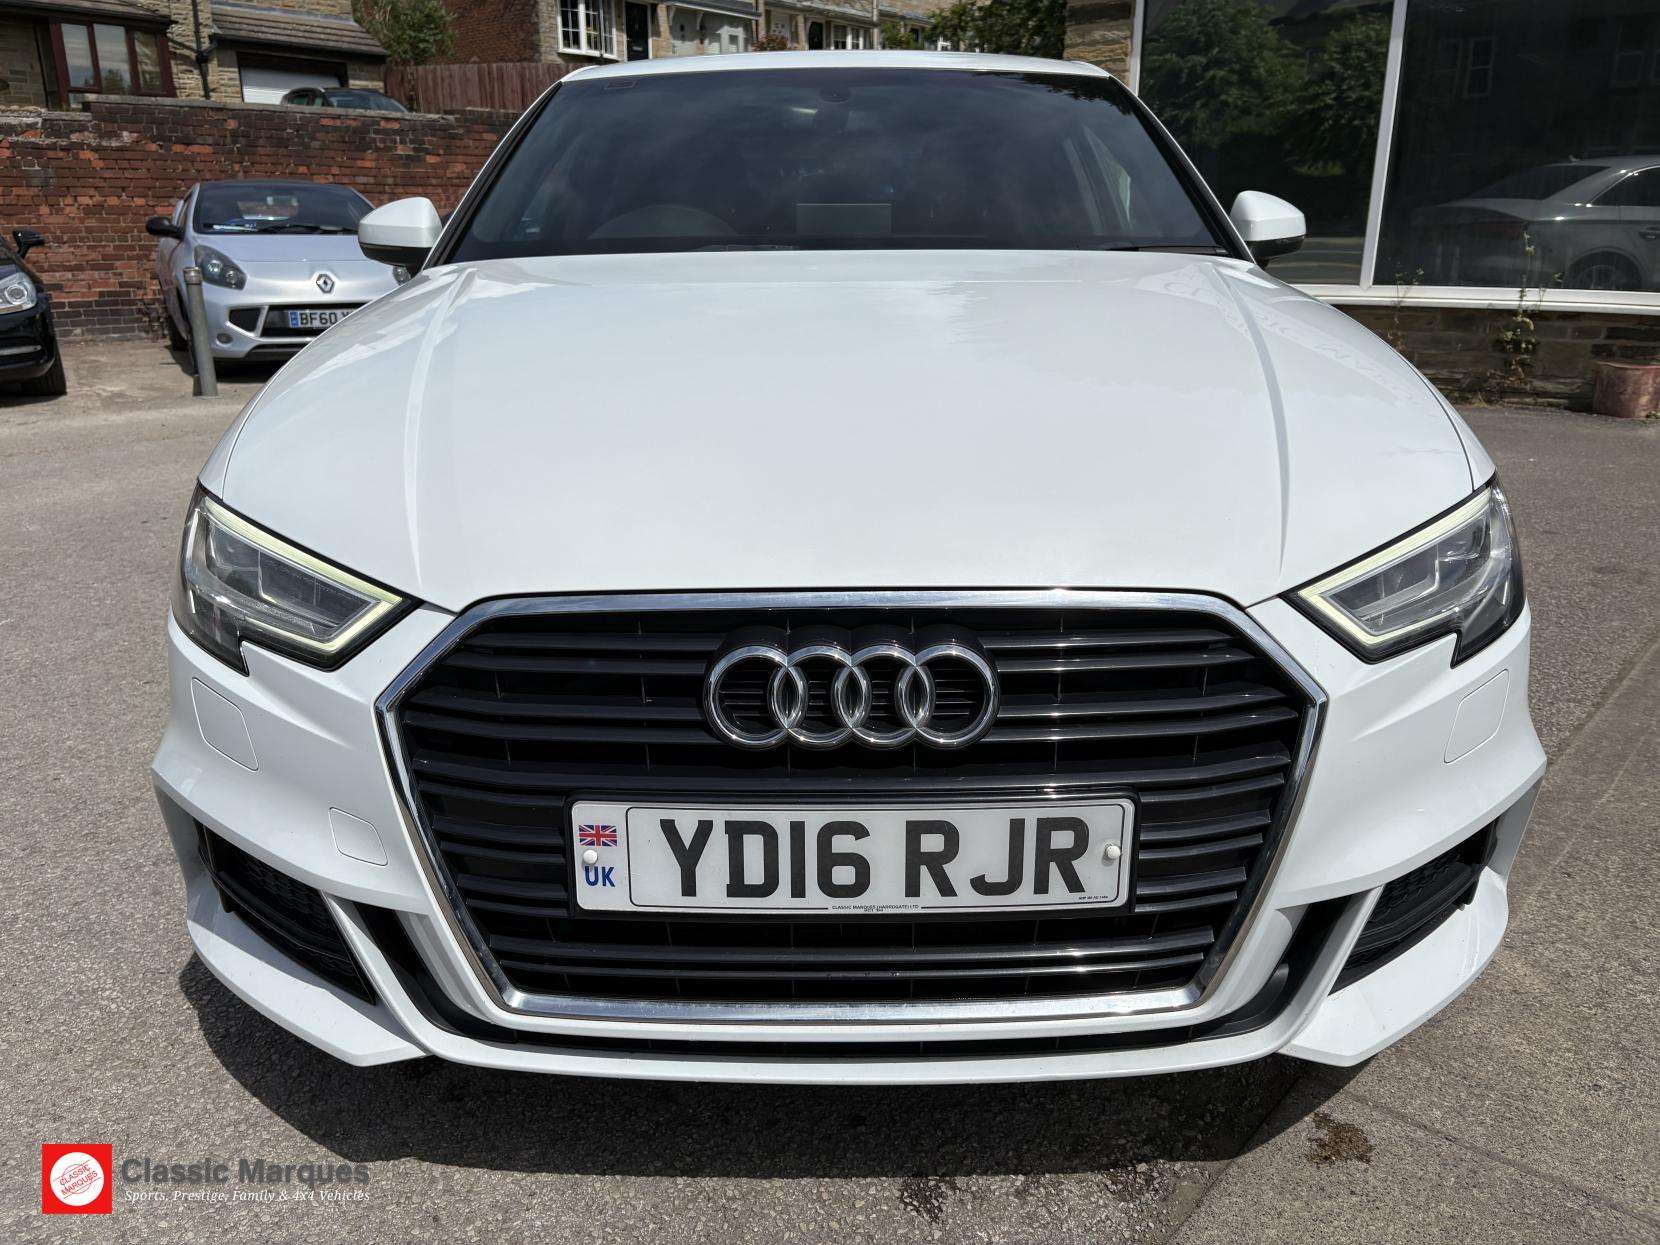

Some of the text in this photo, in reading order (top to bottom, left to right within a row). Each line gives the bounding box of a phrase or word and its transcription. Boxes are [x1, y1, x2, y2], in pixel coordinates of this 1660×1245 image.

[300, 312, 338, 325] BF60
[660, 816, 1090, 899] YD16 RJR
[585, 866, 616, 887] UK
